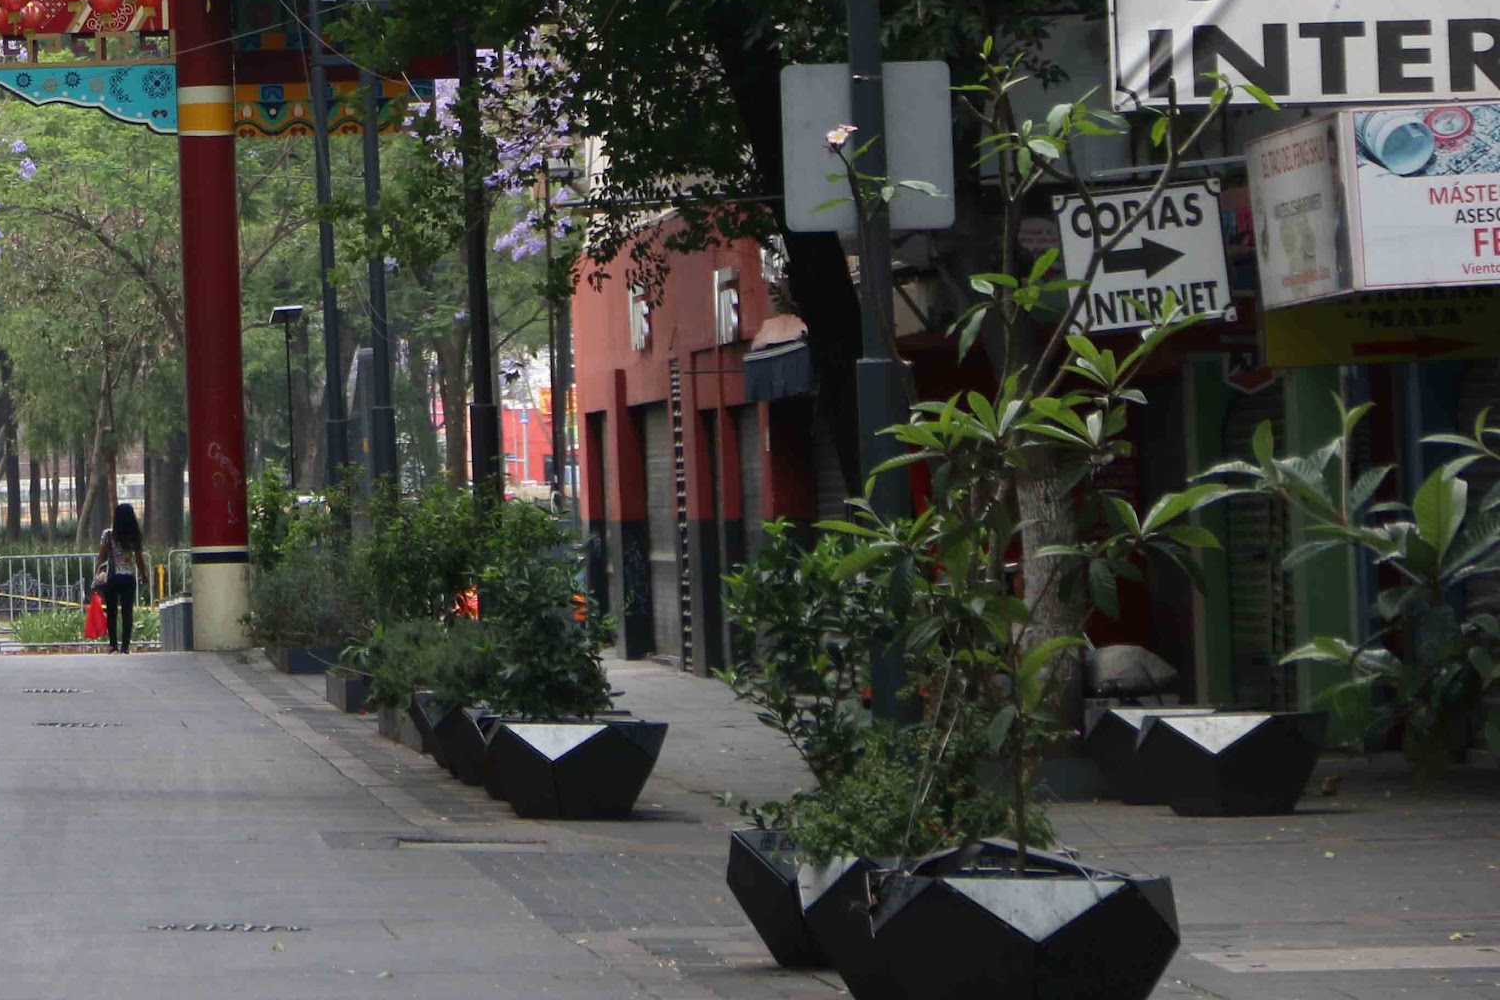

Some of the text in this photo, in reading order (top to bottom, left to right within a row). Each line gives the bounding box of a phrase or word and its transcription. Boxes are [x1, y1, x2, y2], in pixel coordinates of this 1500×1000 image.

[1147, 18, 1500, 98] INTER
[1071, 192, 1204, 239] COPIAS
[1429, 181, 1500, 205] MÁSTE
